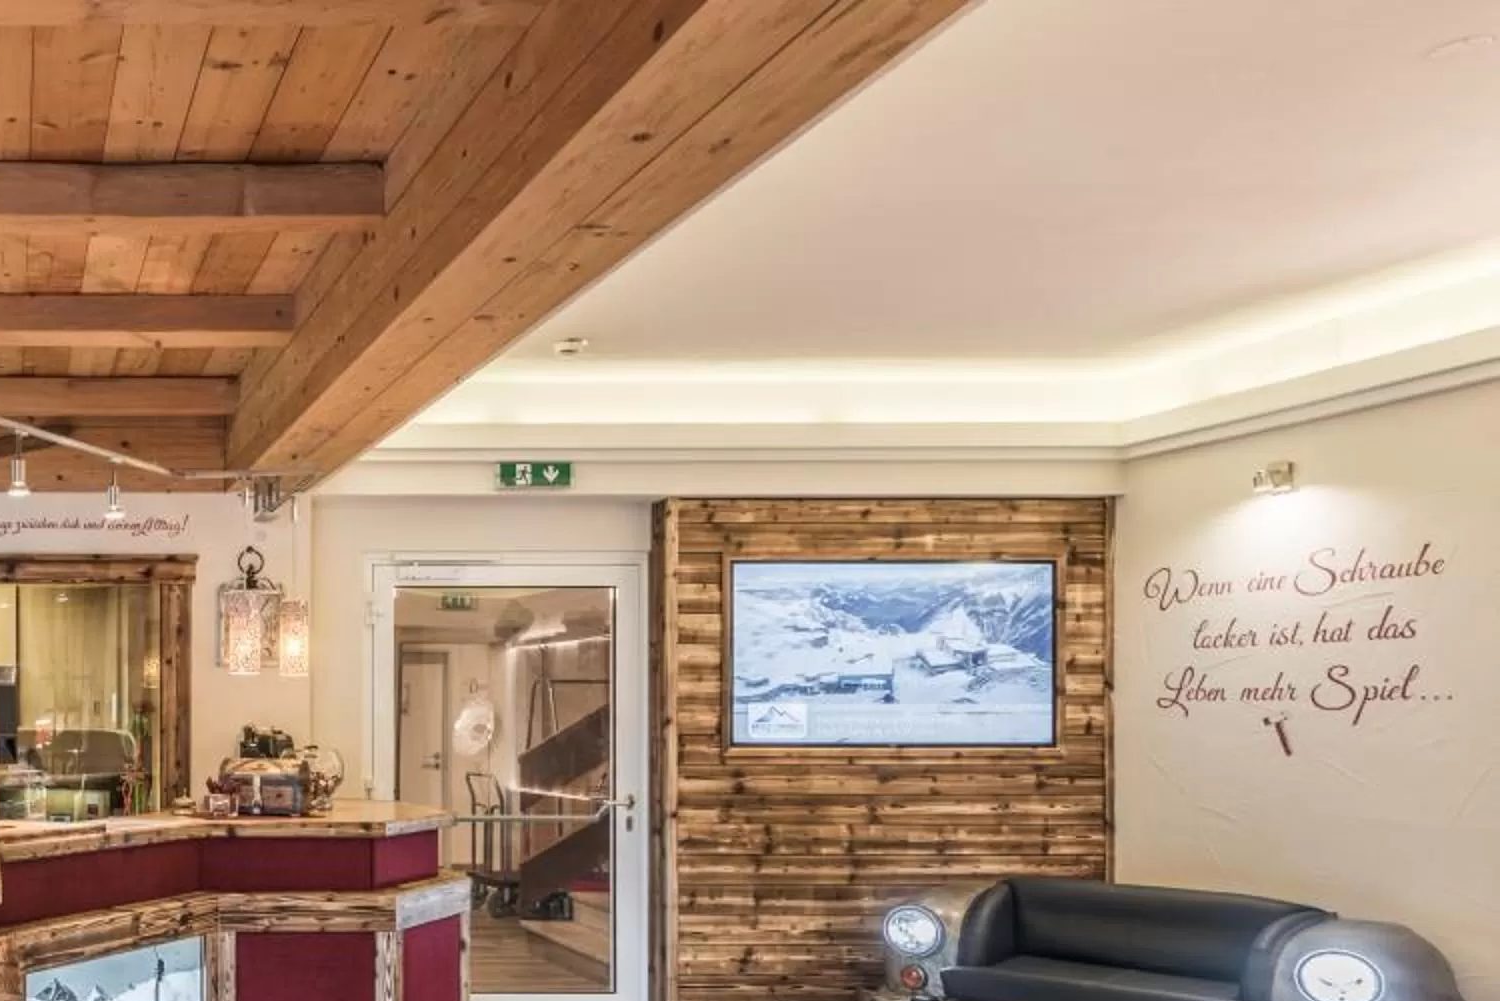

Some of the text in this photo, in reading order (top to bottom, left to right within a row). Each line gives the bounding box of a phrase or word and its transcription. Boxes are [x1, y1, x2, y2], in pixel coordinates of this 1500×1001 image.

[1144, 542, 1445, 611] Wenn eine Schraube
[1193, 605, 1418, 649] locker ist, hat das
[1156, 664, 1454, 726] Leben mehr Spiel...
